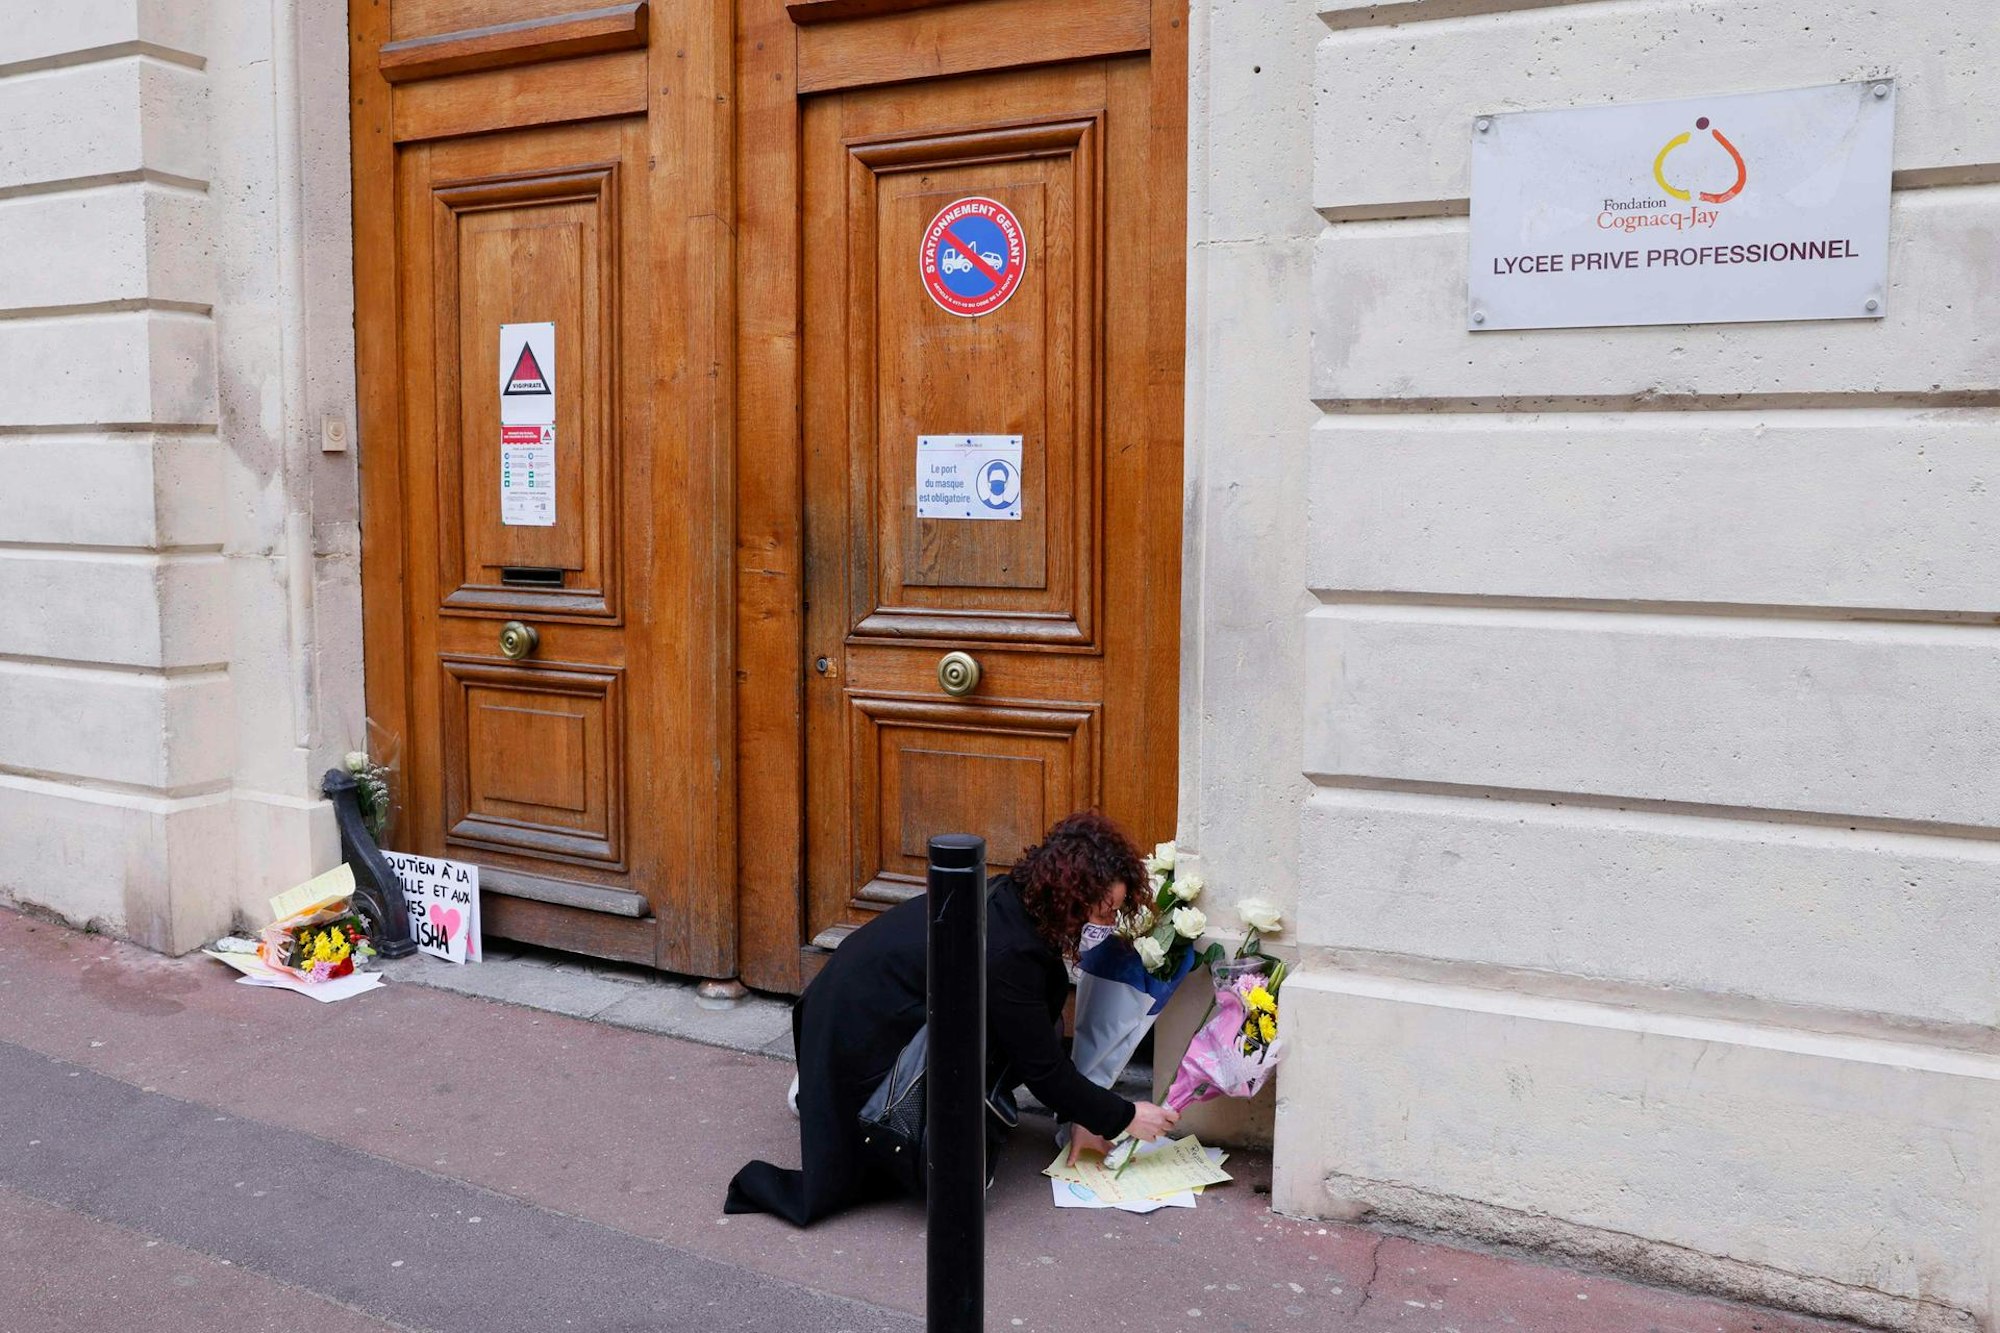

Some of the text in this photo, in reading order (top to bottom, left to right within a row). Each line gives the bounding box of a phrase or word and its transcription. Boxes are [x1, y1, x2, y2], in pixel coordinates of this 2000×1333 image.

[1604, 197, 1667, 211] Fondation
[1597, 206, 1719, 233] Cognacq-Jay
[925, 203, 1020, 274] STATIONNEMENT GENANT
[1494, 239, 1859, 275] LYCEE PRIVE PROFESSIONNEL
[930, 464, 957, 476] Le port
[925, 478, 965, 490] du masque
[919, 493, 970, 505] est obligatoire
[442, 862, 453, 880] À
[456, 868, 470, 884] LA
[433, 884, 450, 898] ET
[451, 889, 471, 905] AUX
